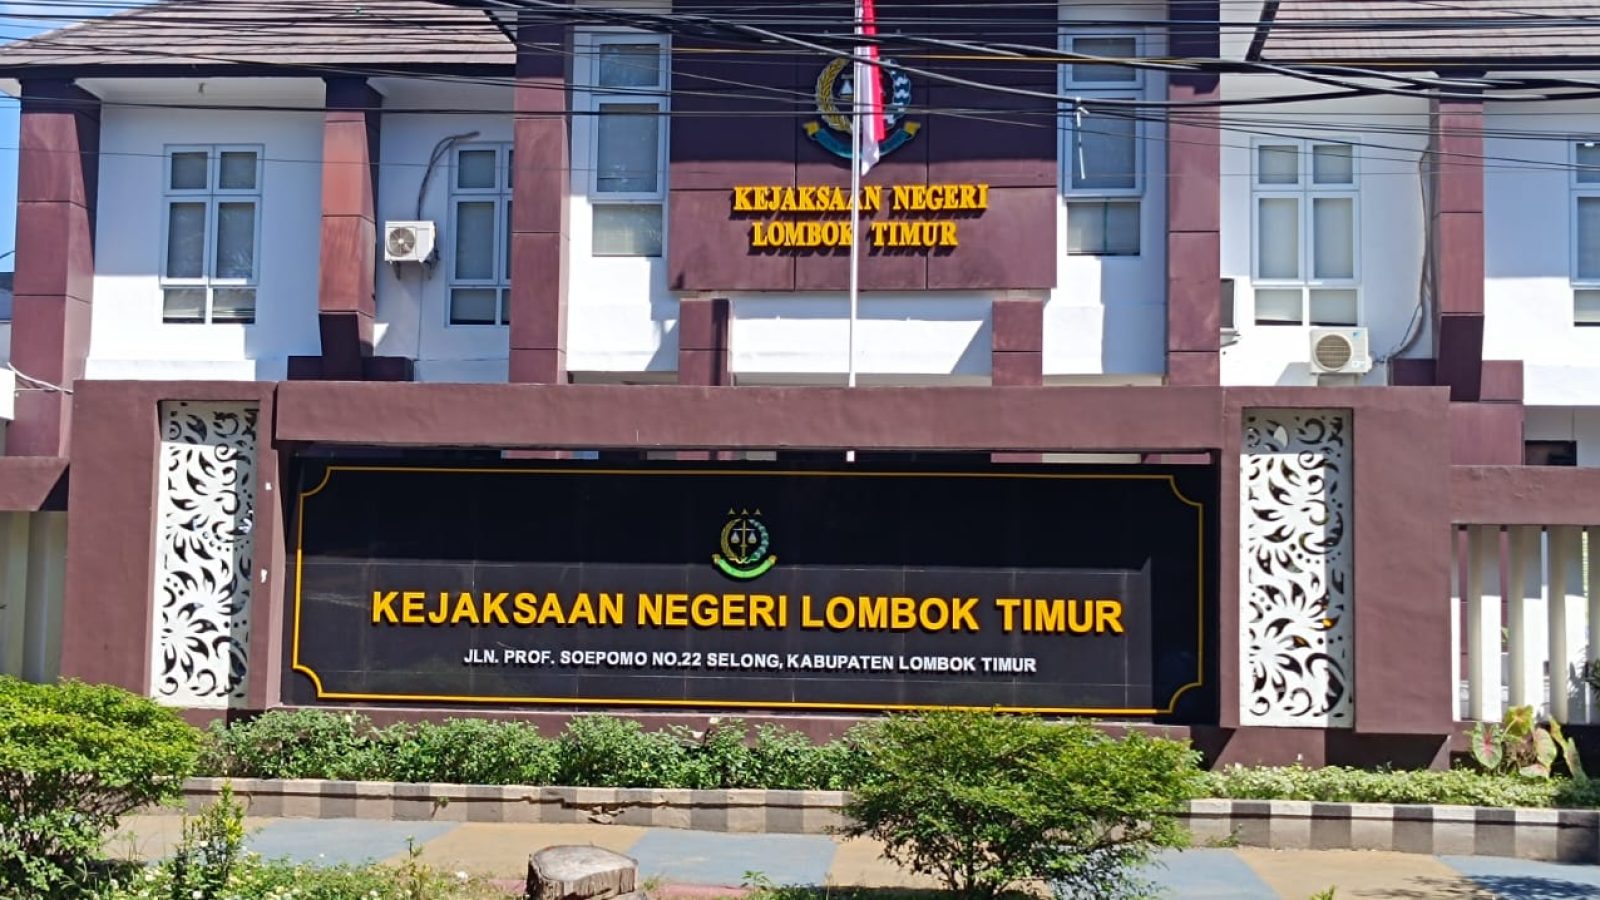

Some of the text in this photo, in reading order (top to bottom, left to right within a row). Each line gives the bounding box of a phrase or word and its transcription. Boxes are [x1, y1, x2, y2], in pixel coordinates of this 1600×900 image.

[892, 184, 990, 210] NEGERI
[872, 220, 959, 247] TIMUR
[371, 591, 1124, 633] KEJAKSAAN NEGERI LOMBOK TIMUR
[463, 648, 1037, 673] JLN. PROF. SOEPOMO NO.22 SELONG, KABUPATEN LOMBOK TIMUR
